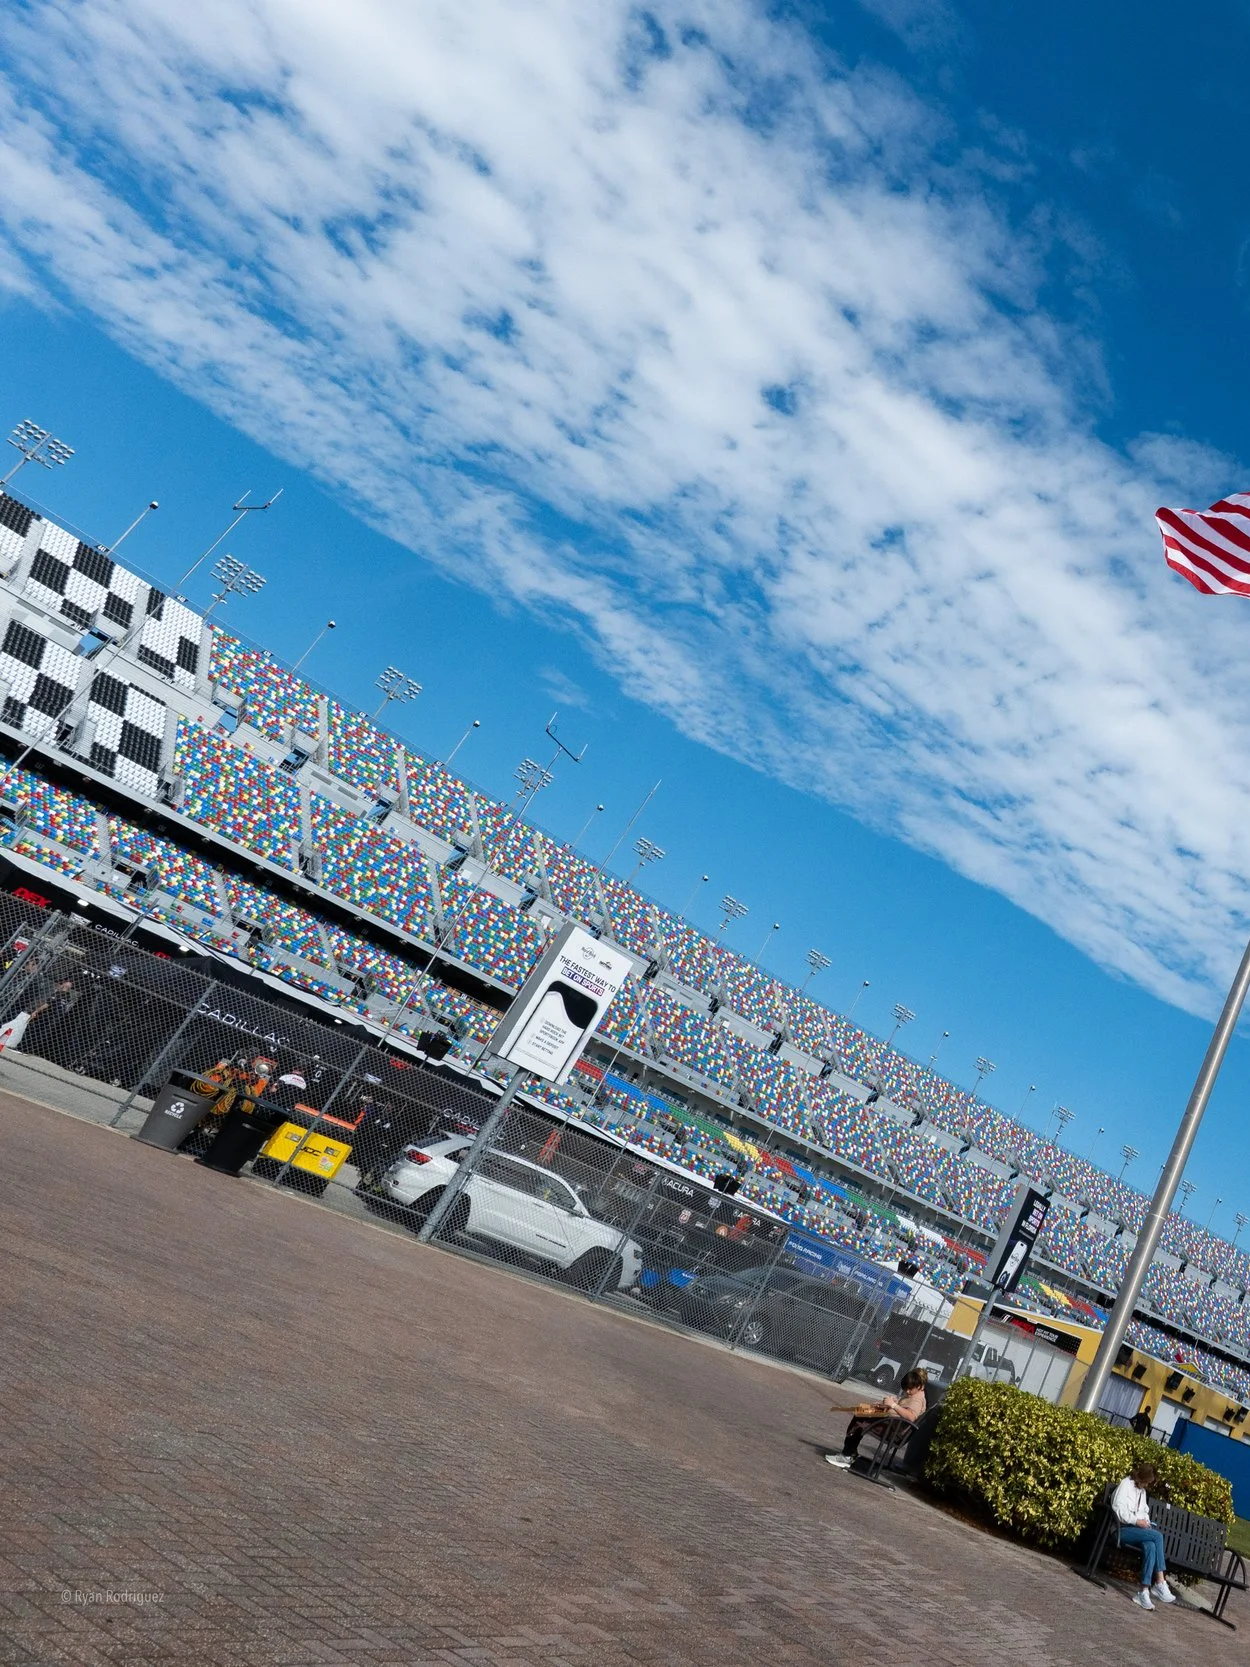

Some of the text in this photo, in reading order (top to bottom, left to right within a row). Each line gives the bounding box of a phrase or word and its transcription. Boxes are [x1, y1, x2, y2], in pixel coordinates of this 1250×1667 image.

[558, 955, 616, 993] THE FASTEST WAY TO
[562, 967, 604, 995] BET ON SPORTS
[164, 1109, 182, 1119] RECYCLE
[666, 1179, 695, 1197] ACURA
[737, 1210, 762, 1227] ARA
[1025, 1222, 1037, 1235] FLORIDA
[1035, 1331, 1056, 1343] EXPERIENCE
